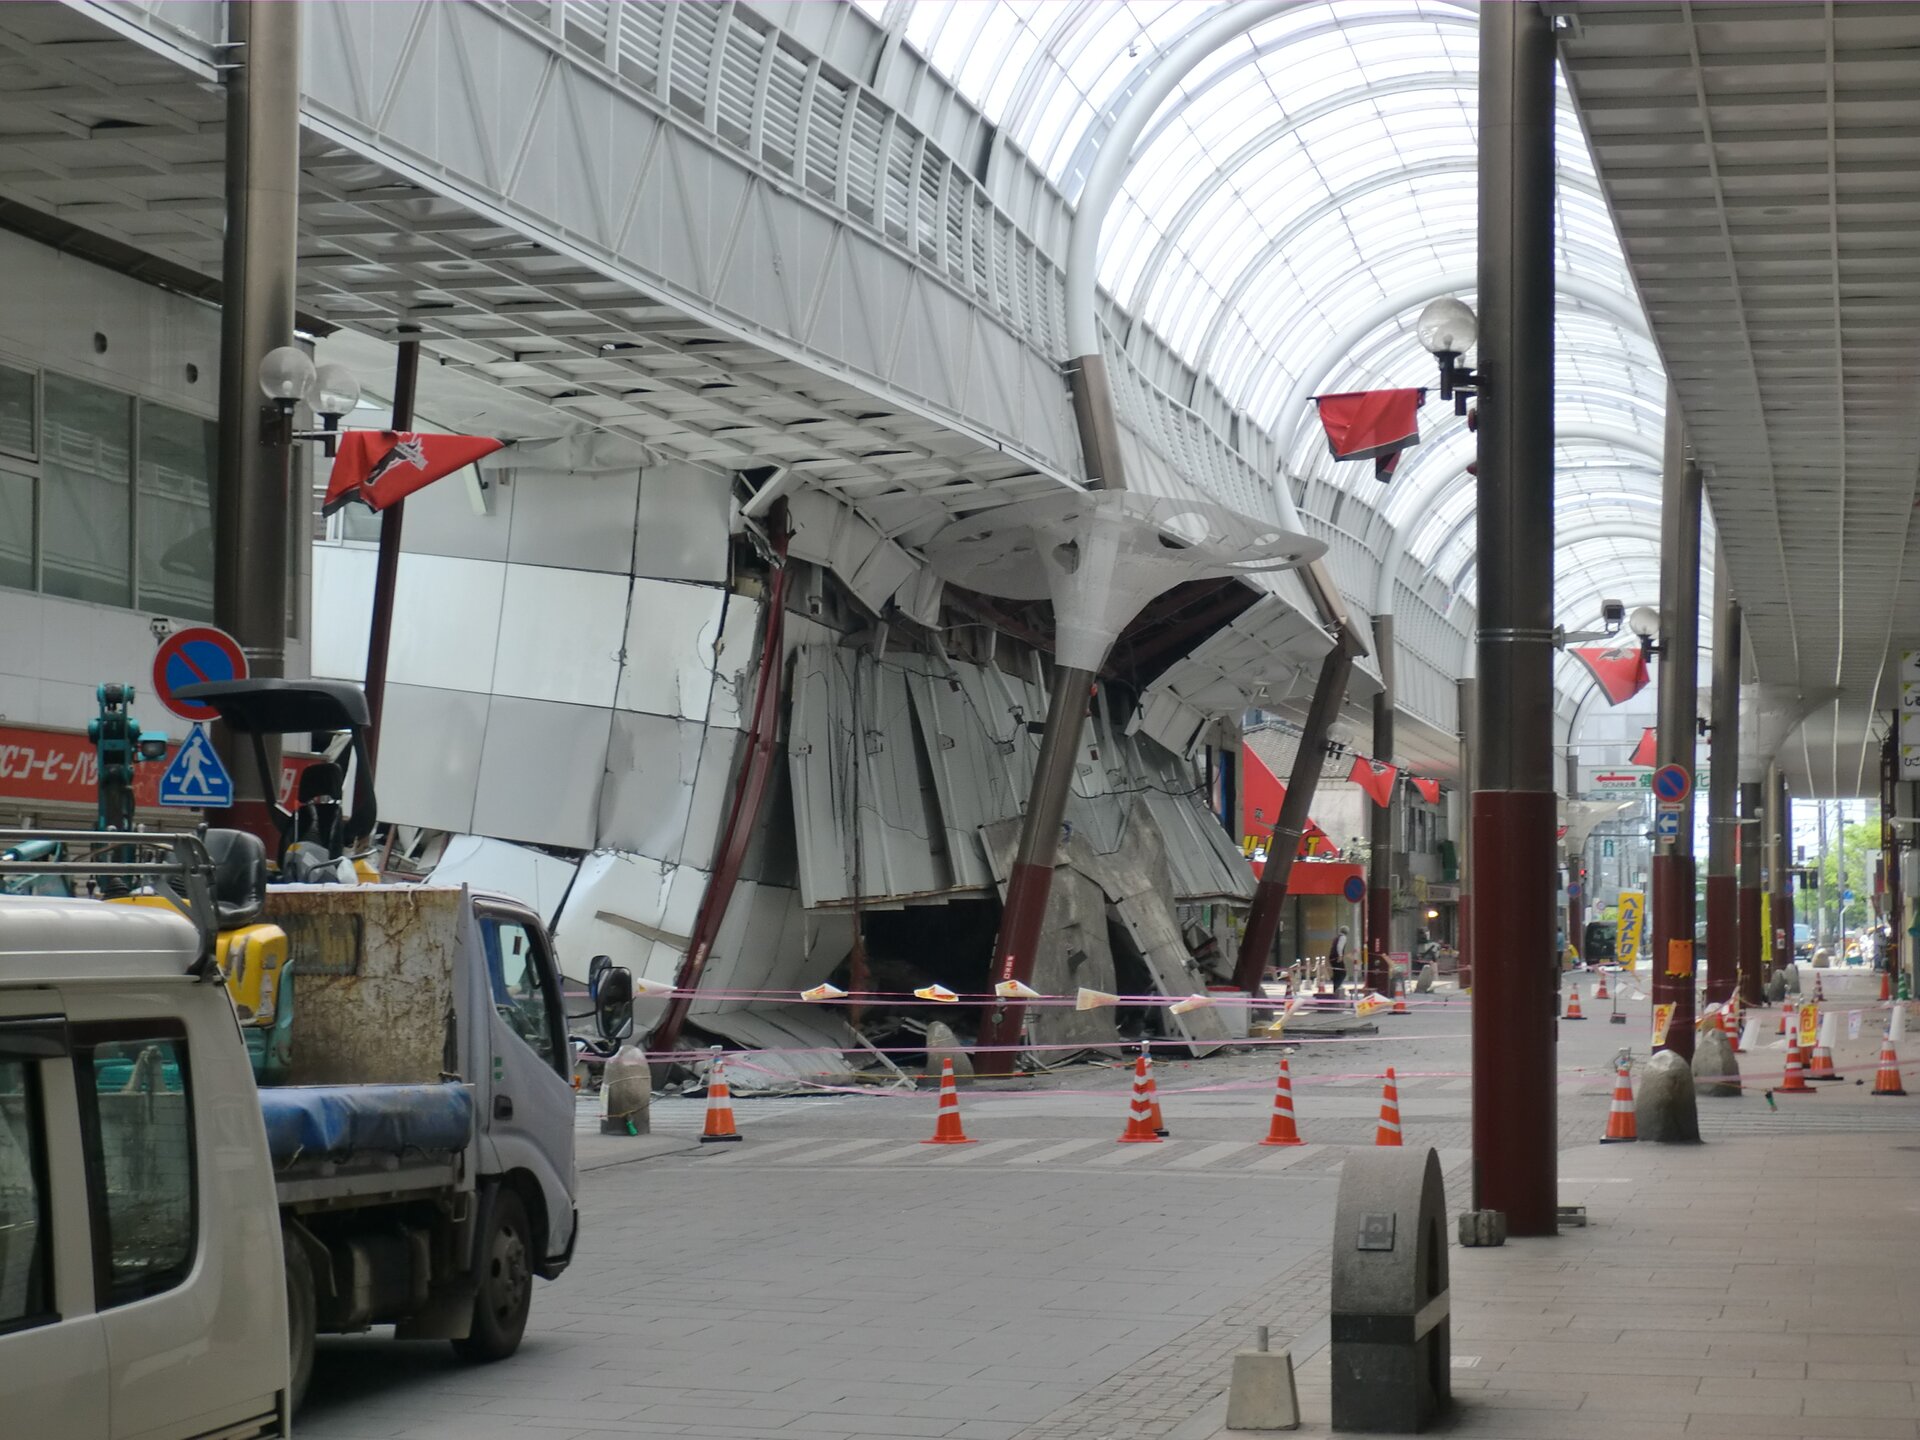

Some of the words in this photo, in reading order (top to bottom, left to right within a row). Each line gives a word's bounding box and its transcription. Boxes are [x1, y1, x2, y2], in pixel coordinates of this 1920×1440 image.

[1617, 897, 1639, 967] ヘルストロン
